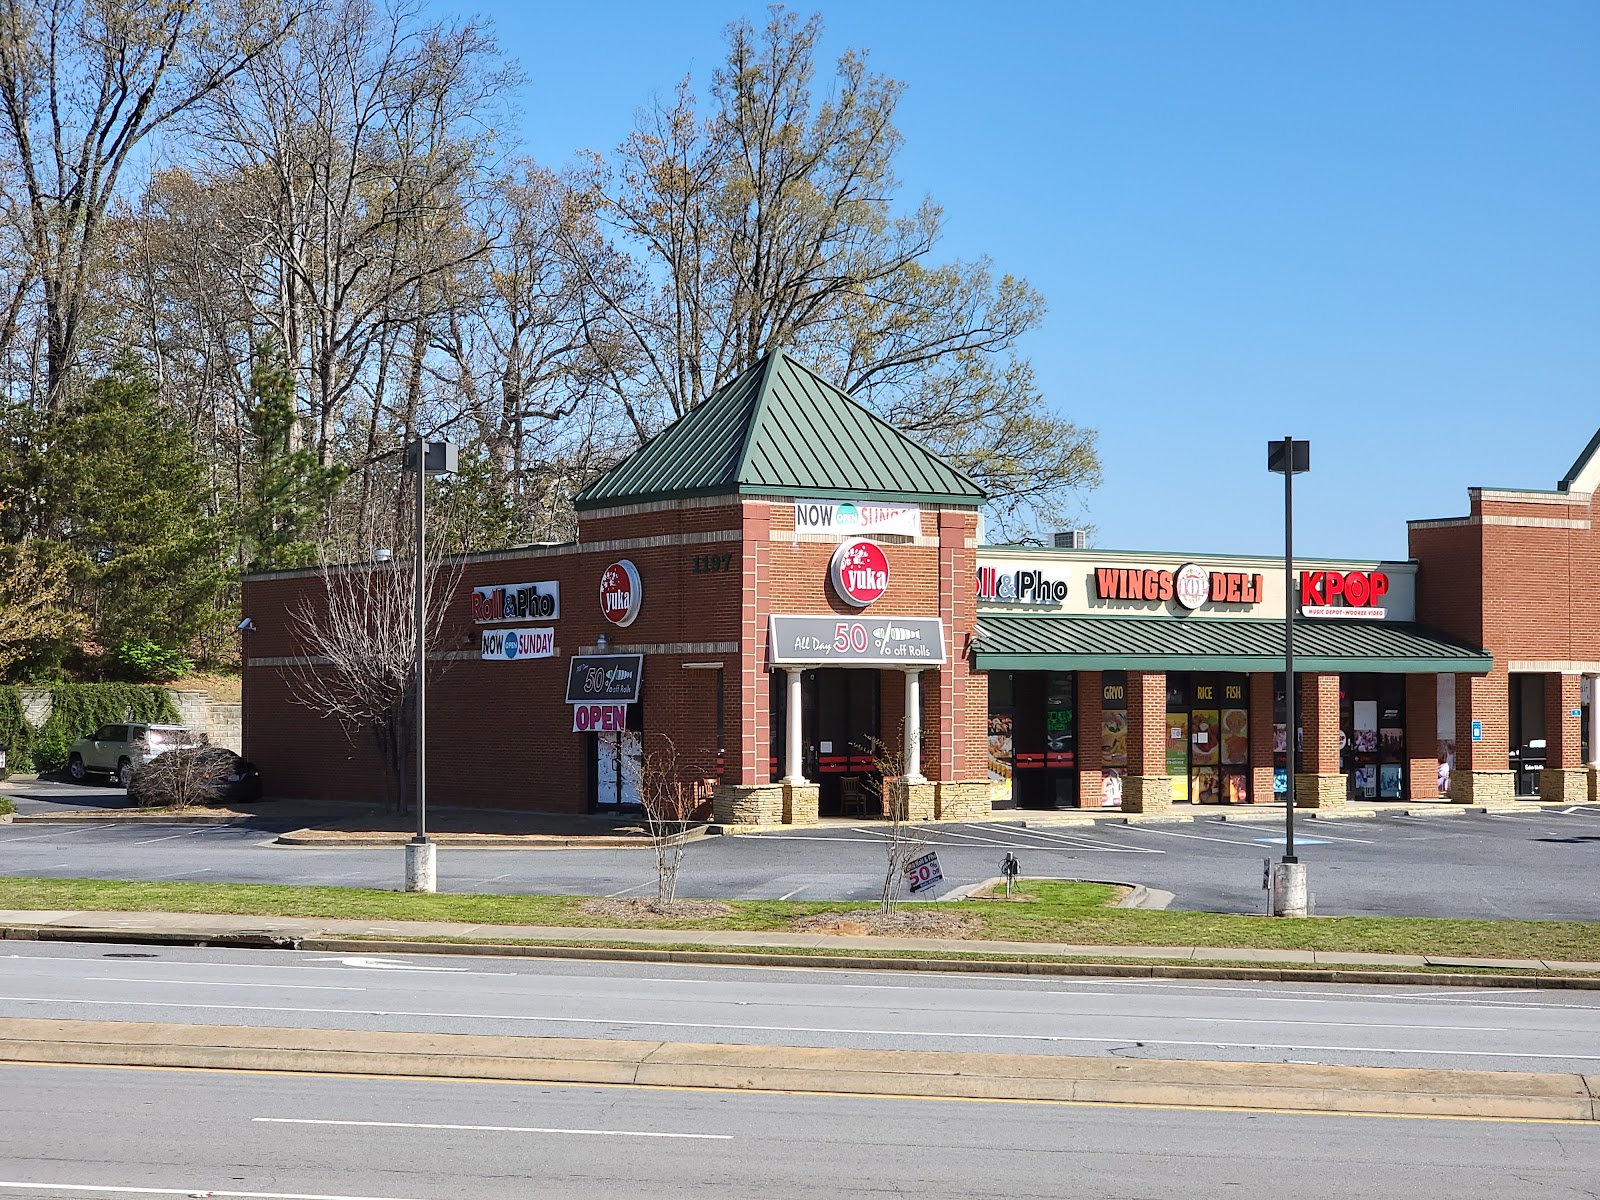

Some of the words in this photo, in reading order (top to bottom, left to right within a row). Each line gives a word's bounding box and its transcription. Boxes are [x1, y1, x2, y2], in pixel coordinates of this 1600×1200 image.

[797, 505, 833, 526] NOW
[838, 513, 859, 522] OPEN
[693, 554, 732, 573] 1197
[848, 568, 886, 591] yuka
[1096, 568, 1173, 601] WINGS
[1210, 572, 1263, 603] DELI
[1302, 571, 1388, 607] KPOP
[606, 589, 630, 613] yuka
[482, 634, 504, 655] NOW
[505, 641, 518, 649] OPEN
[518, 633, 553, 654] SUNDAY
[794, 637, 810, 650] All
[811, 638, 832, 655] Day
[833, 623, 868, 653] 50
[894, 645, 907, 656] off
[909, 645, 931, 657] Rolls
[583, 667, 605, 693] 50
[1103, 686, 1124, 700] GRYO
[1197, 686, 1213, 700] RICE
[1226, 686, 1241, 699] FISH
[576, 705, 626, 730] OPEN
[909, 865, 930, 887] 50
